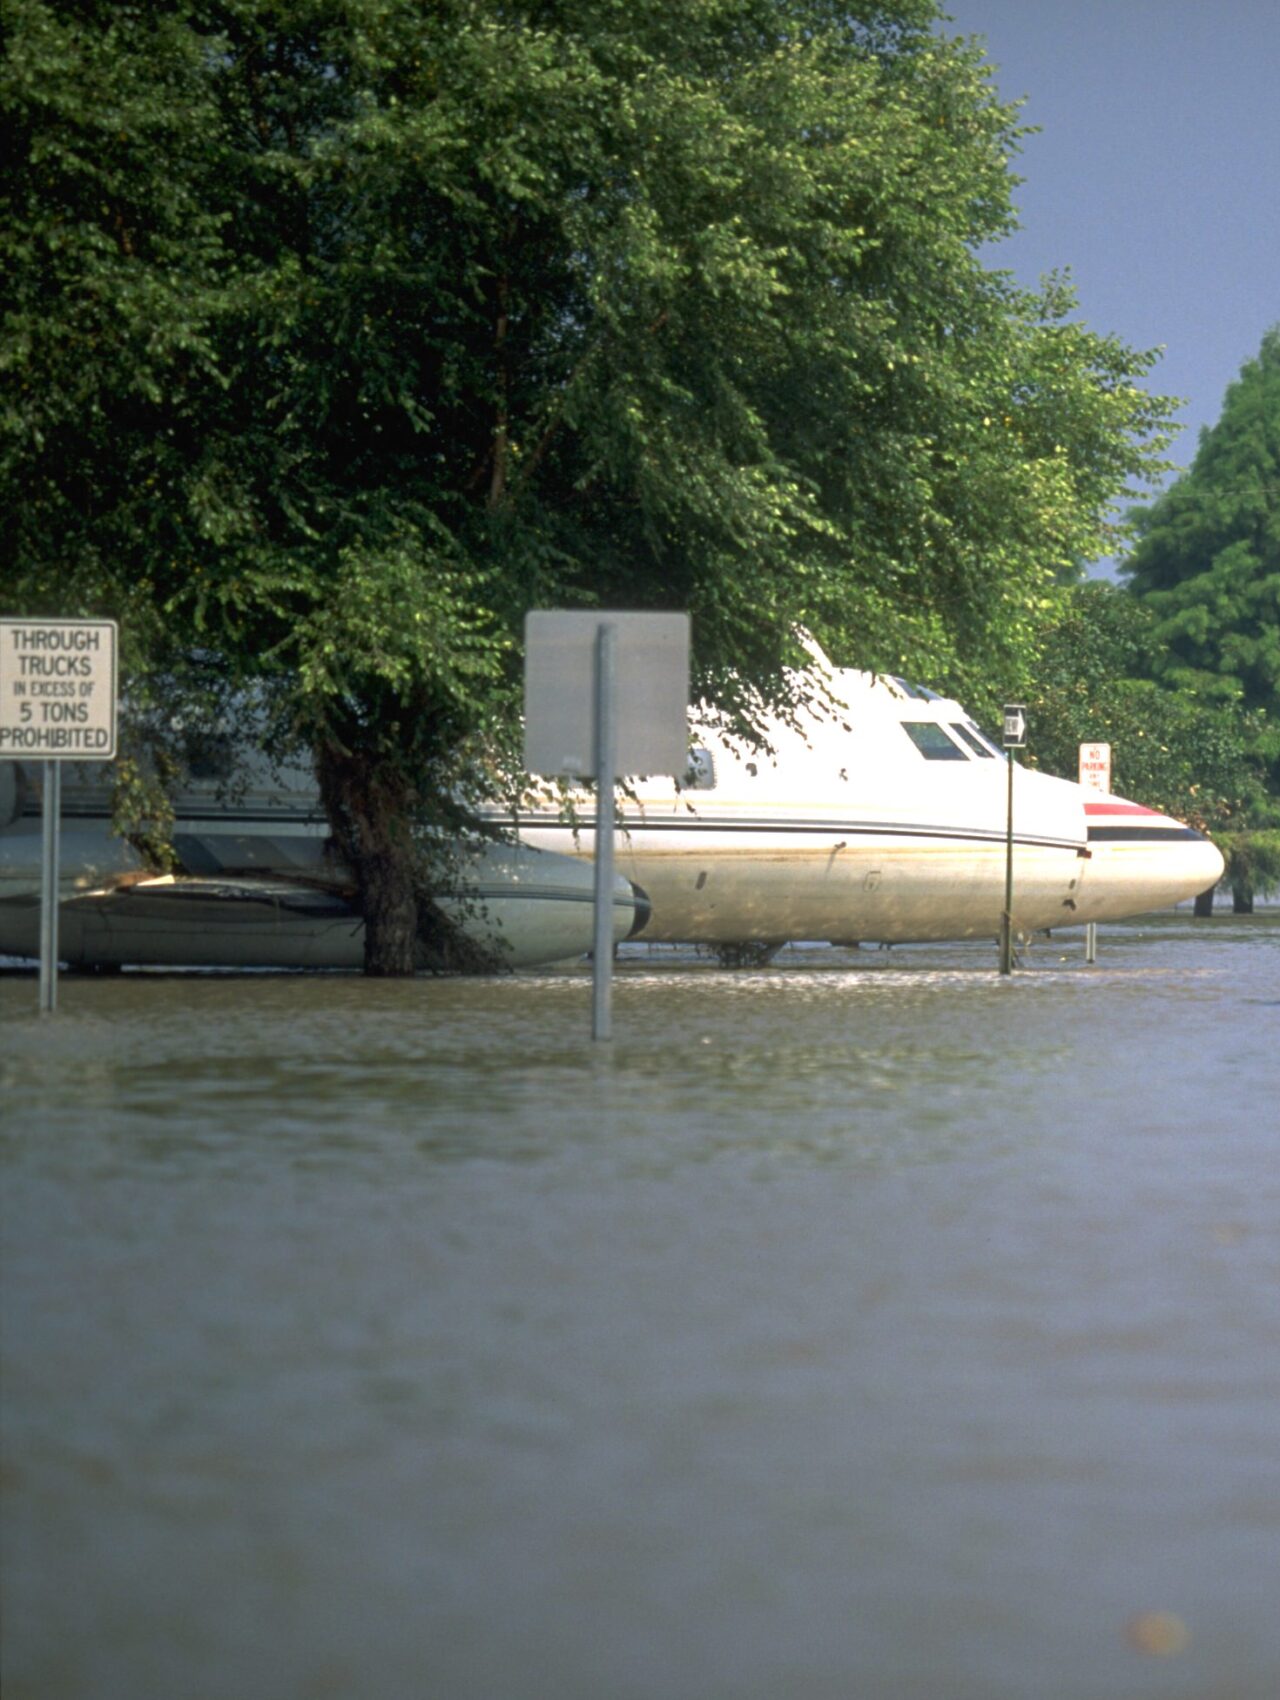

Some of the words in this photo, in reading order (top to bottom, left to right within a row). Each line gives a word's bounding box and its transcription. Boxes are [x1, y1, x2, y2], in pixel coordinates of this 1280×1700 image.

[11, 629, 99, 650] THROUGH
[18, 655, 92, 676] TRUCKS
[13, 681, 26, 697] IN
[30, 681, 75, 697] EXCESS
[79, 681, 94, 697] OF
[20, 702, 32, 722] 5
[40, 702, 89, 722] TONS
[0, 727, 108, 749] PROHIBITED
[1089, 750, 1100, 760] NO
